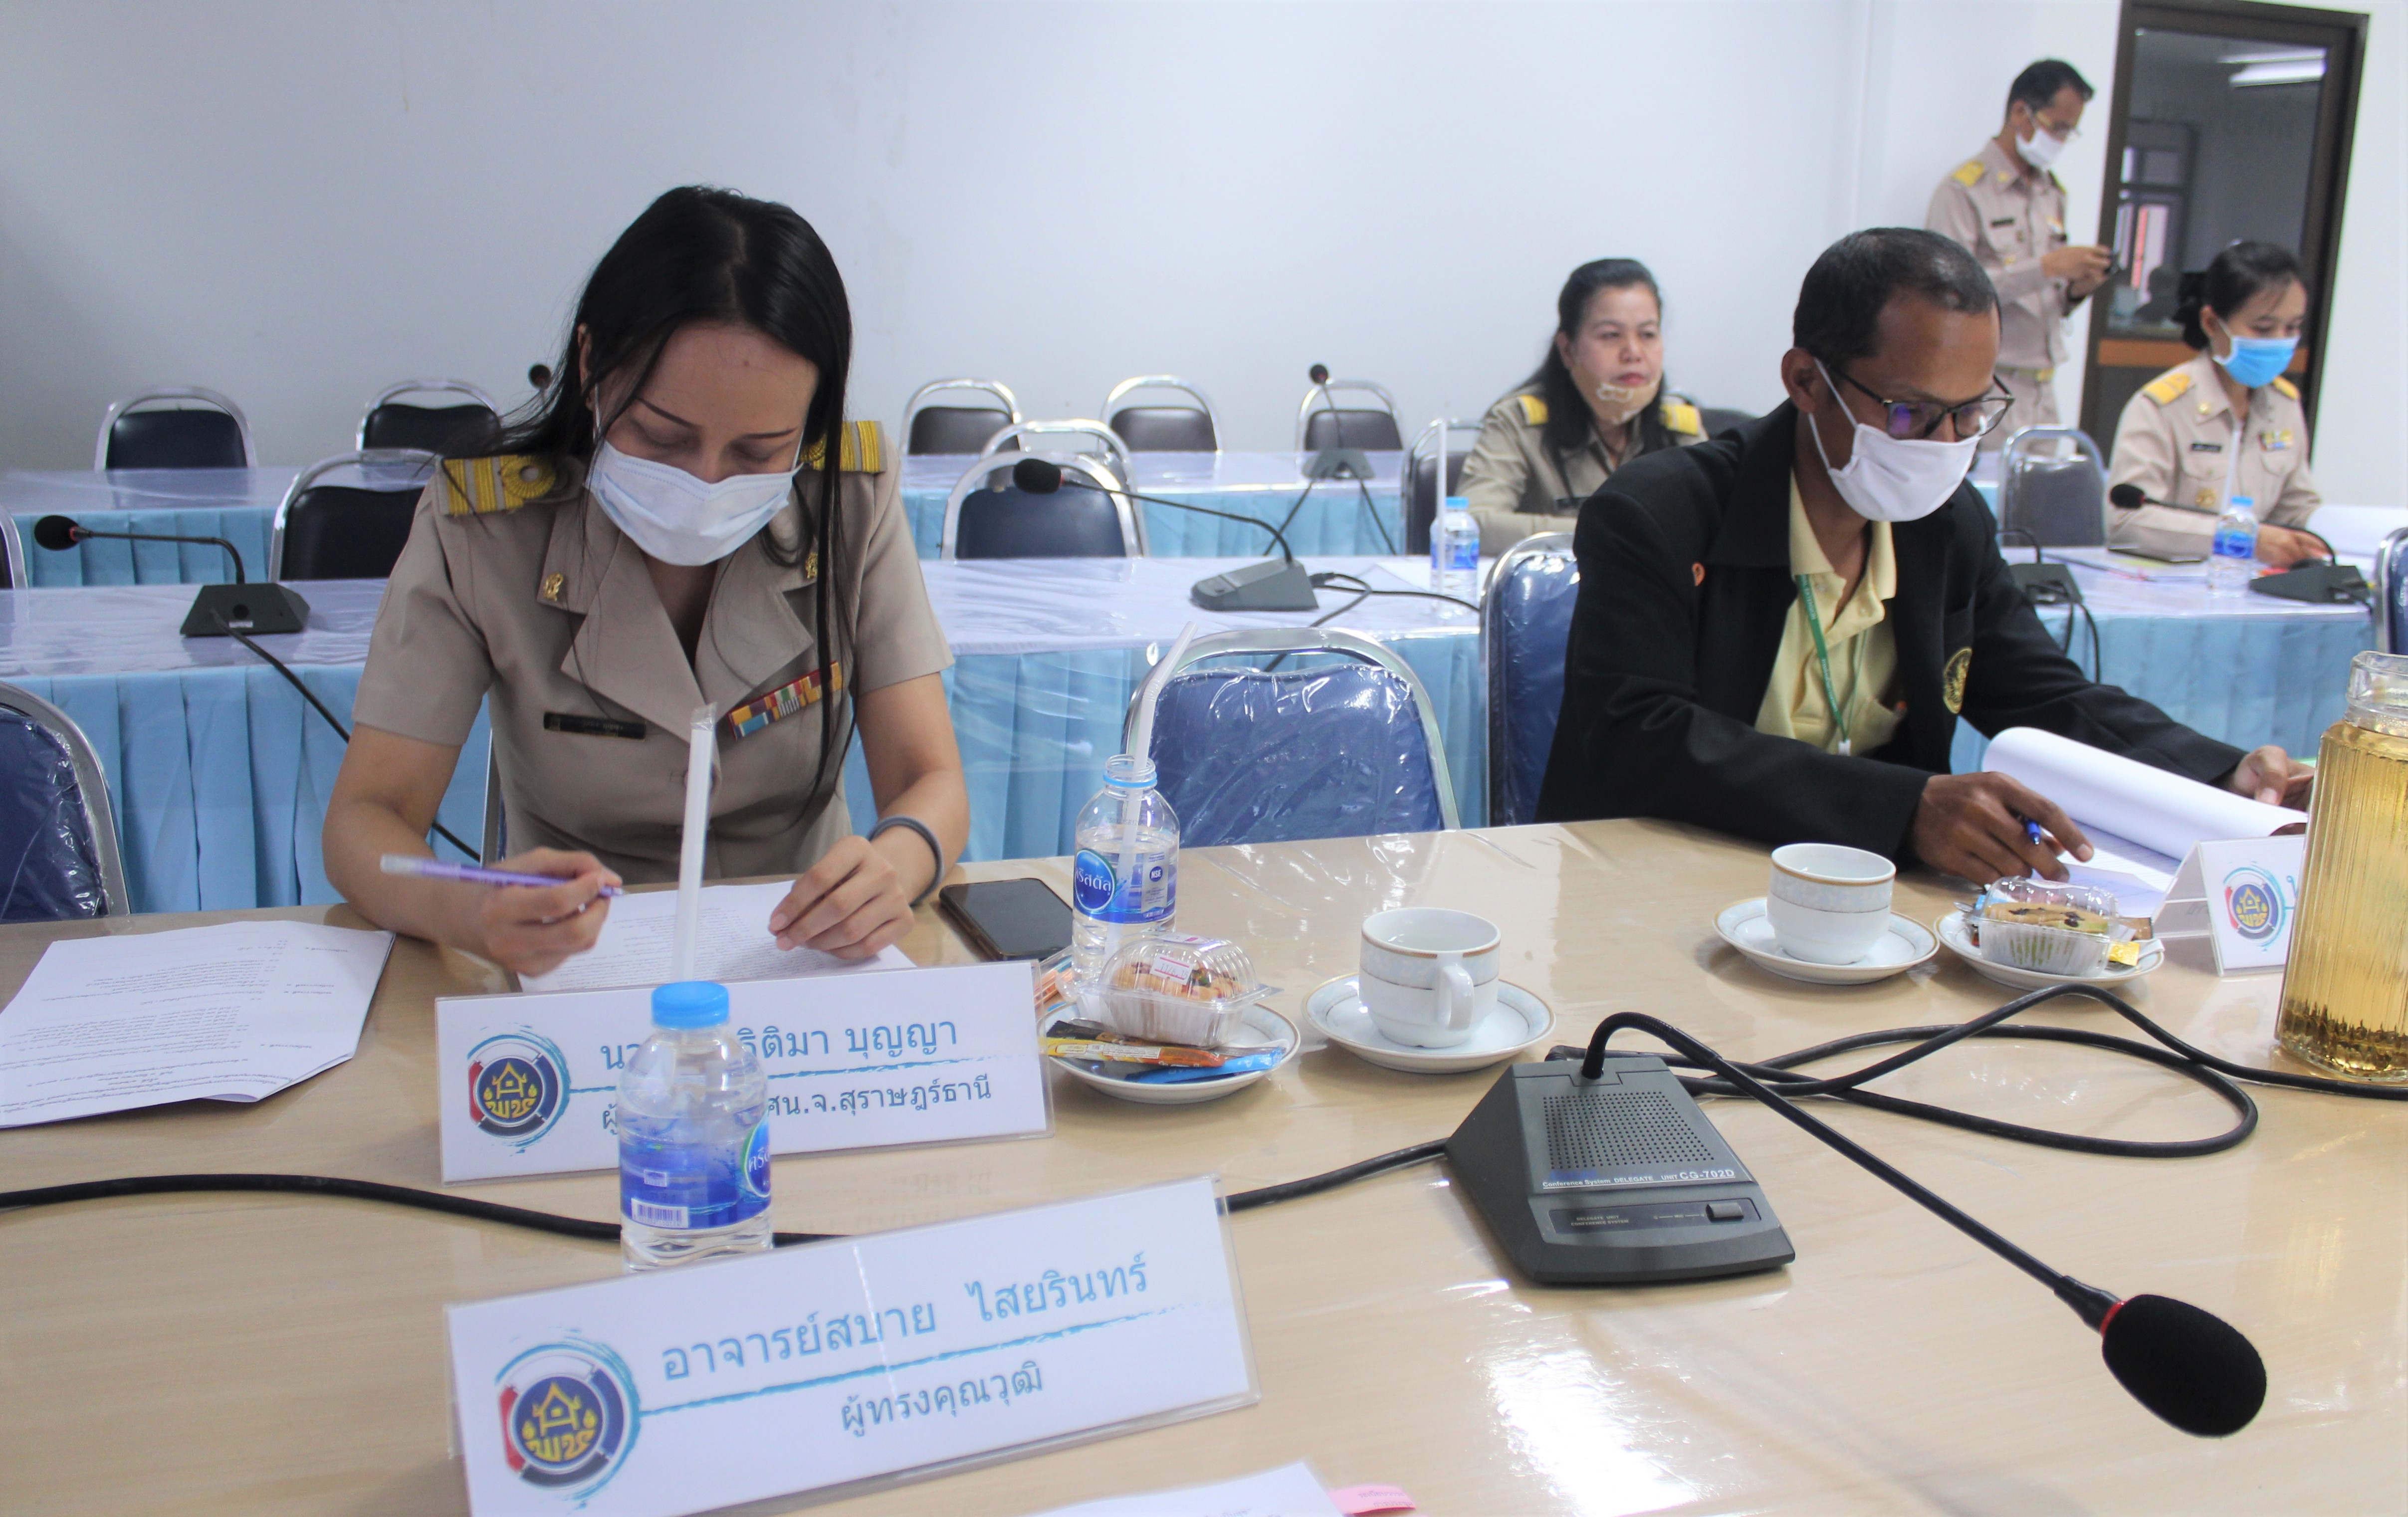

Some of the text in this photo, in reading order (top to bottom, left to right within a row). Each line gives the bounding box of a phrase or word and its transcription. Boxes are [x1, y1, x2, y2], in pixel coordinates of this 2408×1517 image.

[845, 1021, 957, 1059] บุญญา
[1613, 1175, 1654, 1184] DELEGATE
[1679, 1169, 1735, 1180] CG-702D
[662, 1253, 1146, 1381] อาจารย์สบาย ไสยรินทร์
[841, 1360, 1043, 1438] ผู้ทรงคุณวุฒิ
